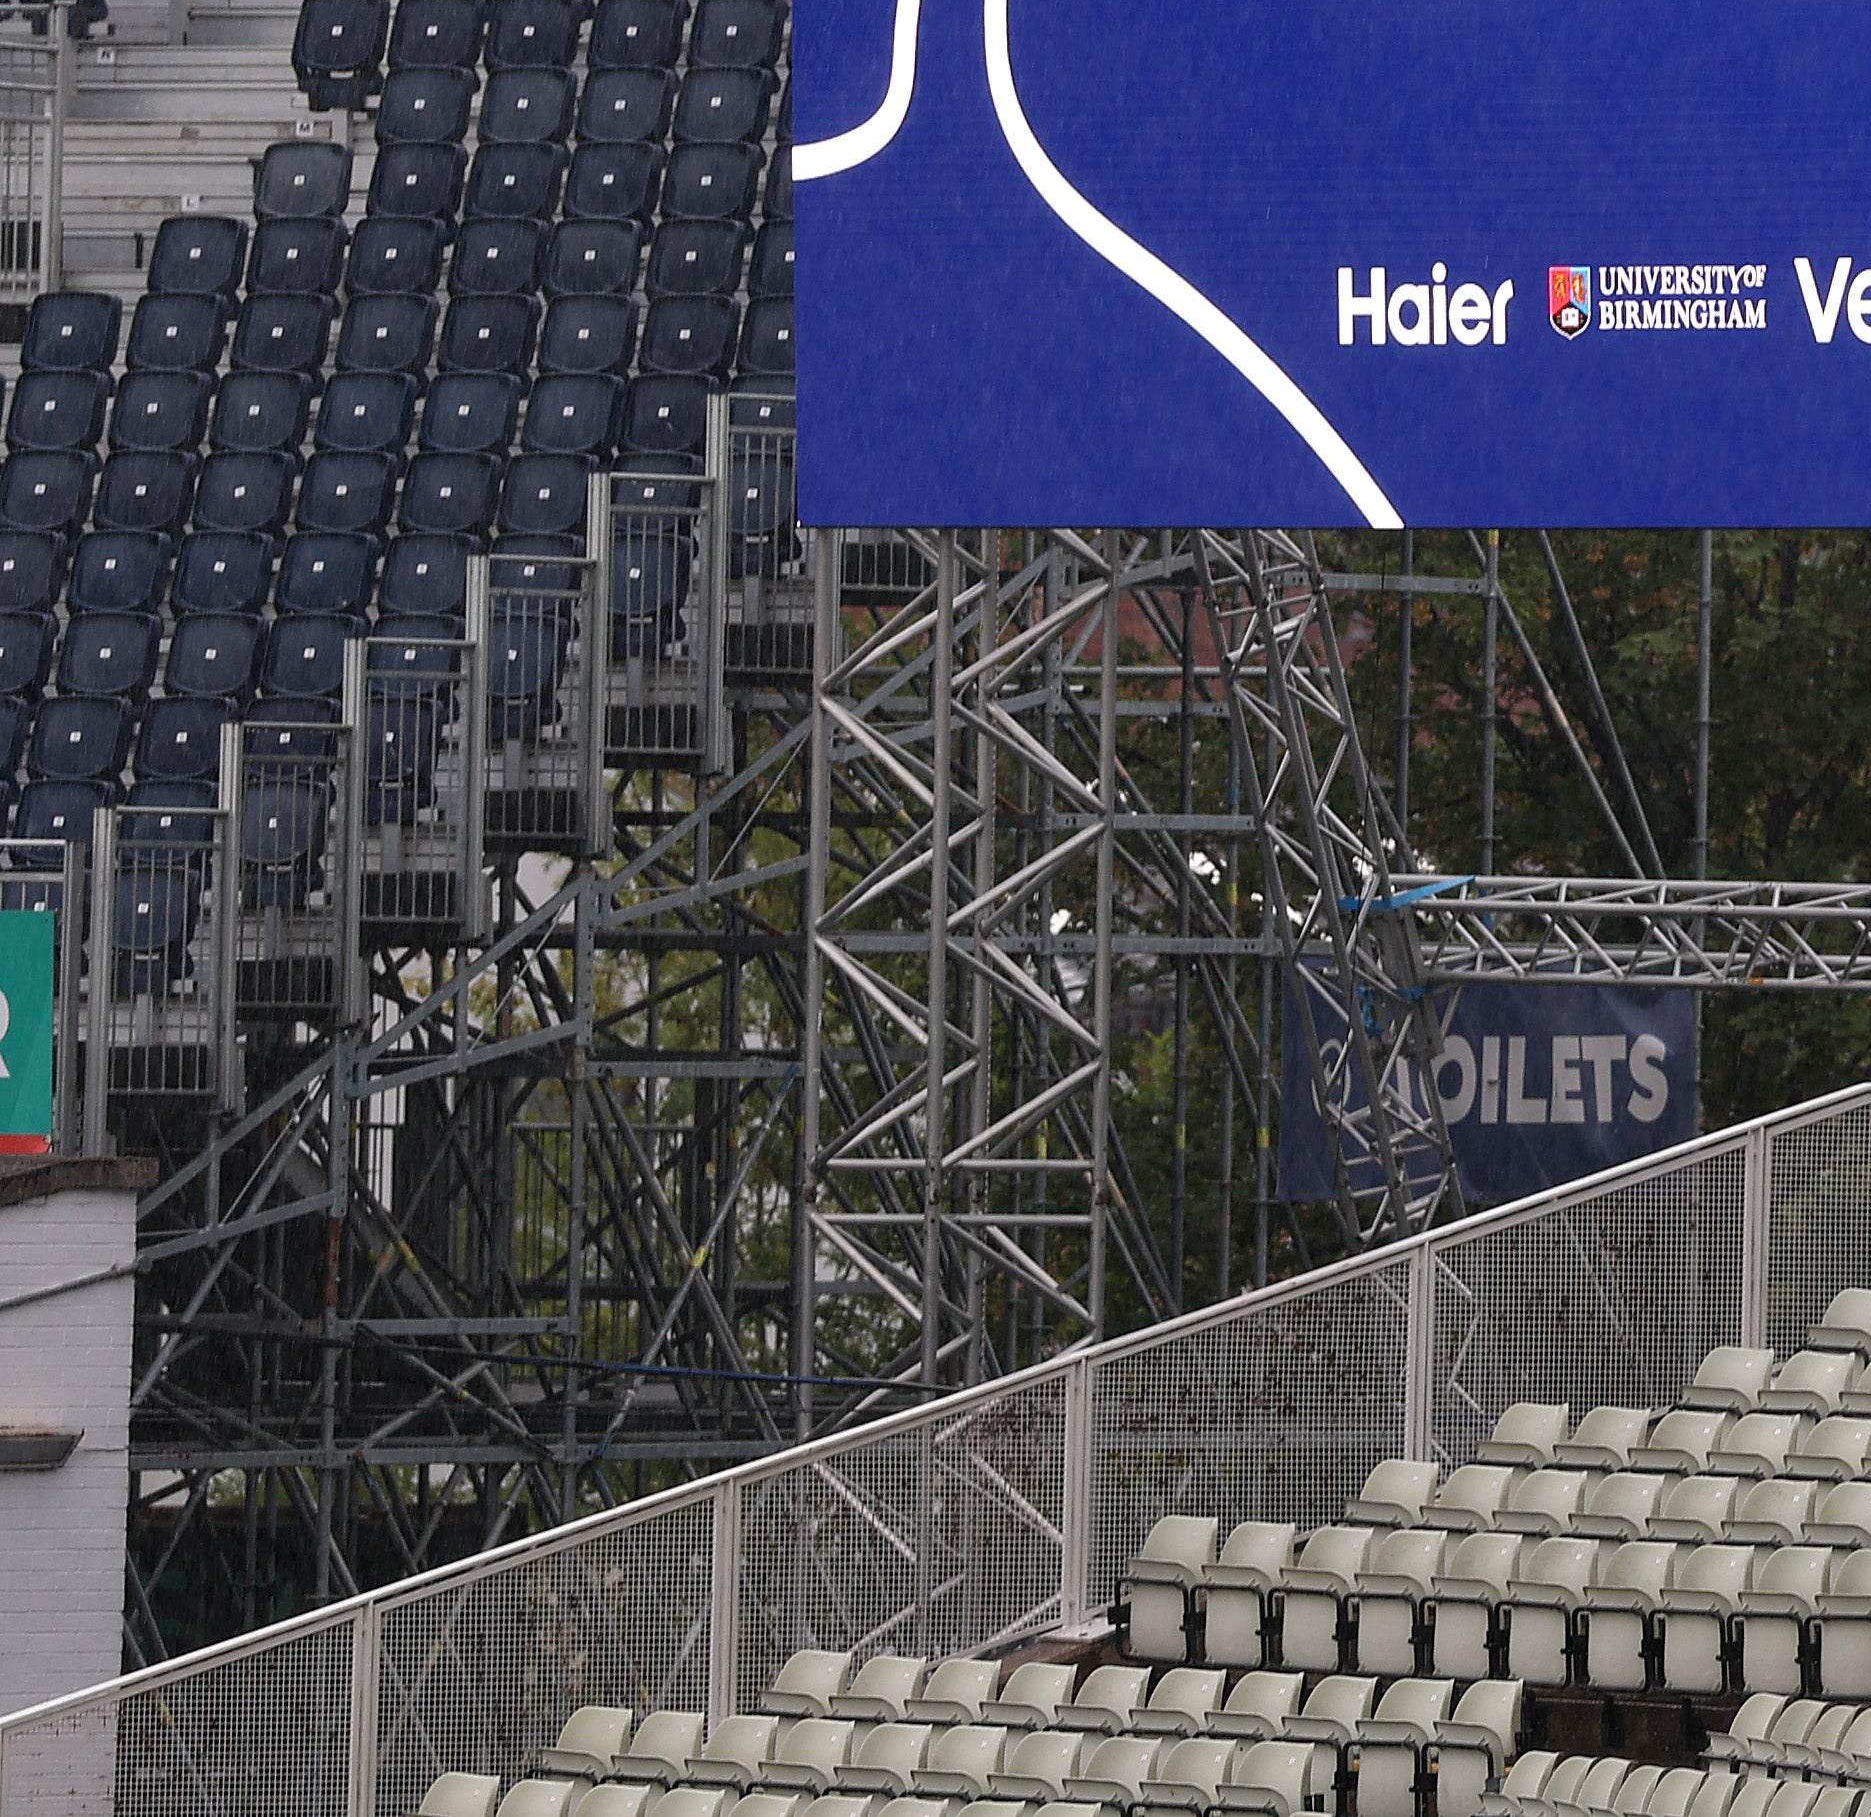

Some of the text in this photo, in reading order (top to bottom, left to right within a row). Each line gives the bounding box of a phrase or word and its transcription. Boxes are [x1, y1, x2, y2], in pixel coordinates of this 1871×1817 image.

[1598, 264, 1750, 296] UNIVERSITY
[1337, 262, 1514, 346] Haier
[1598, 299, 1768, 330] BIRMINGHAM
